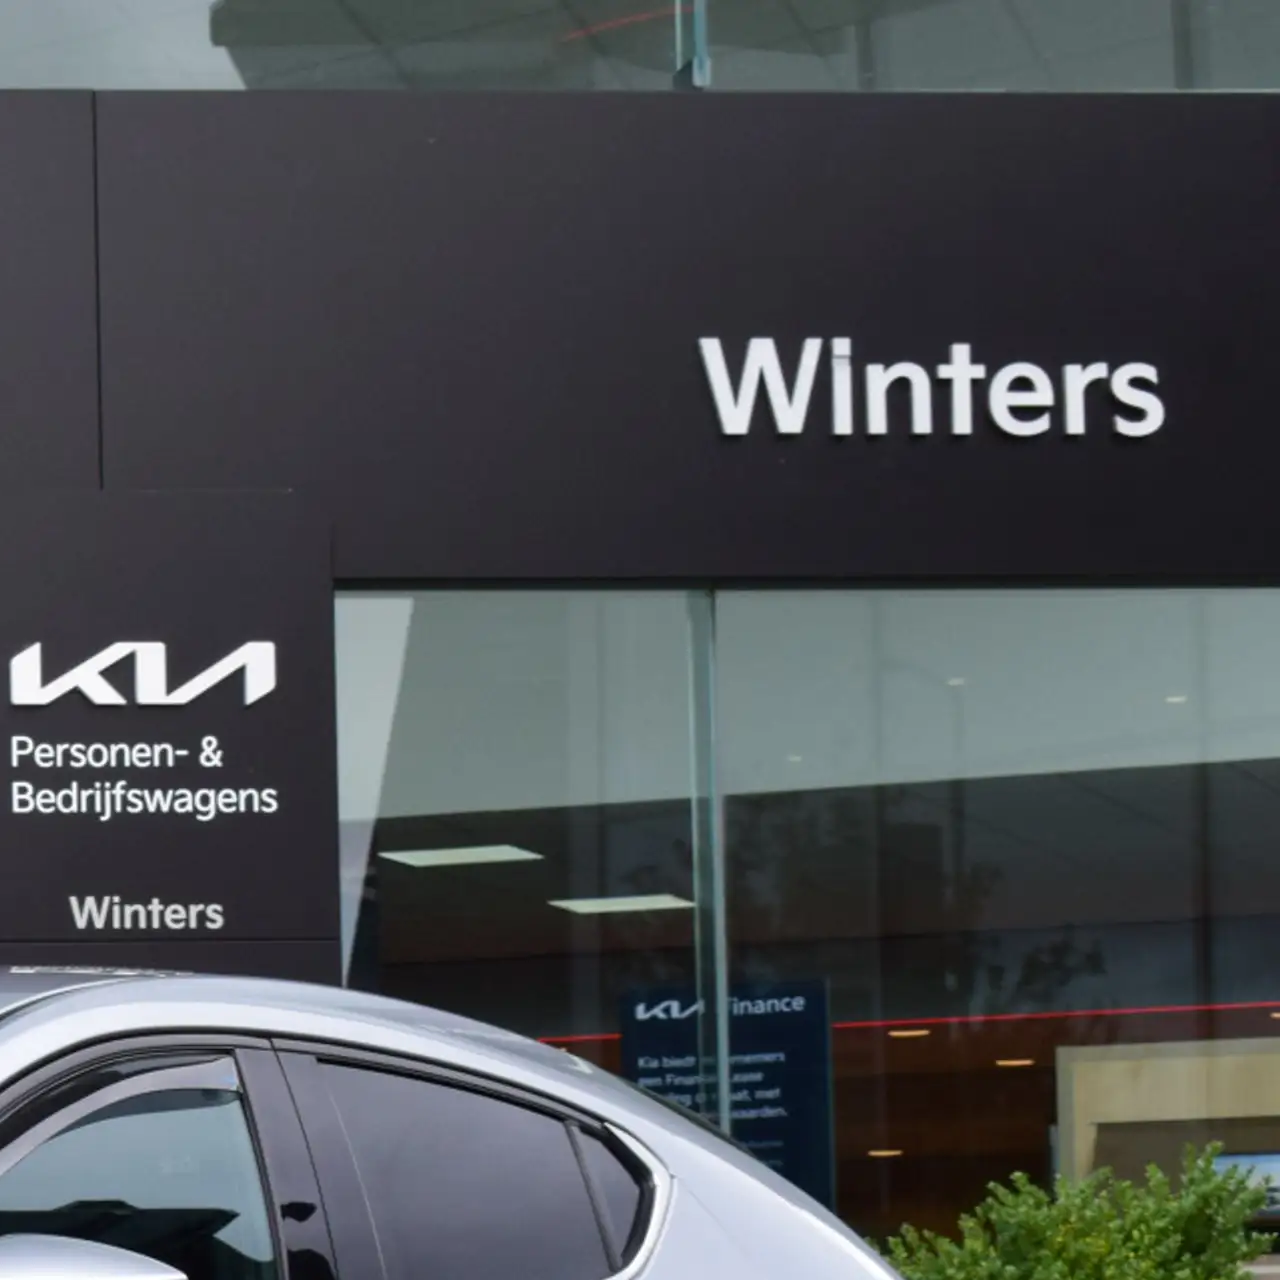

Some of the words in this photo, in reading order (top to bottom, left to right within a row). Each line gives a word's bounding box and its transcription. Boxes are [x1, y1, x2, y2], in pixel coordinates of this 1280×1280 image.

[698, 336, 1166, 438] Winters
[10, 641, 276, 706] KIA
[11, 735, 189, 768] Personen-
[198, 735, 224, 768] &
[11, 781, 279, 821] Bedrijfswagens
[69, 895, 225, 929] Winters
[729, 996, 806, 1016] inance
